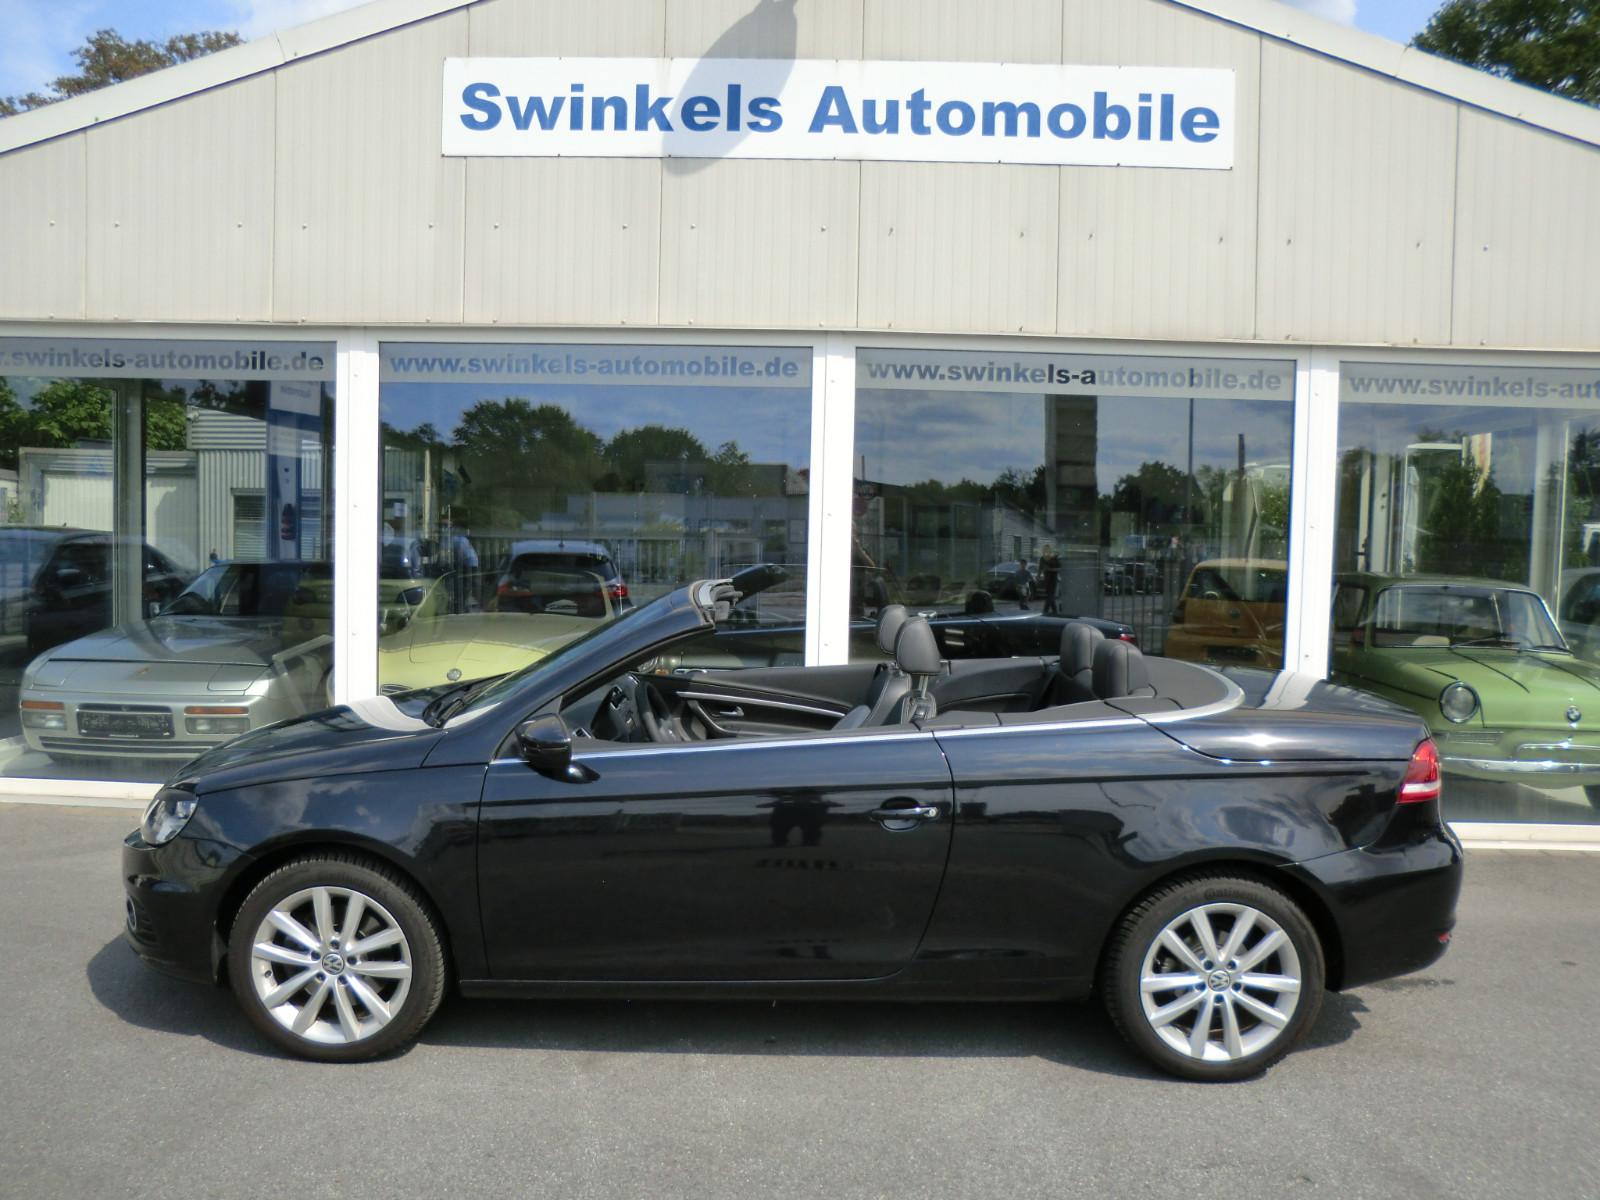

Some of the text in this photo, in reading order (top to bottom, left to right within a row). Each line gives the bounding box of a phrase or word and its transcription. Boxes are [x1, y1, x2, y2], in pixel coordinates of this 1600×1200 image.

[459, 82, 1221, 143] Swinkels Automobile
[0, 348, 324, 371] .swinkels-automobile.de
[390, 353, 799, 377] www.swinkels-automobile.de
[867, 362, 1281, 391] www.swinkels-automobile.de
